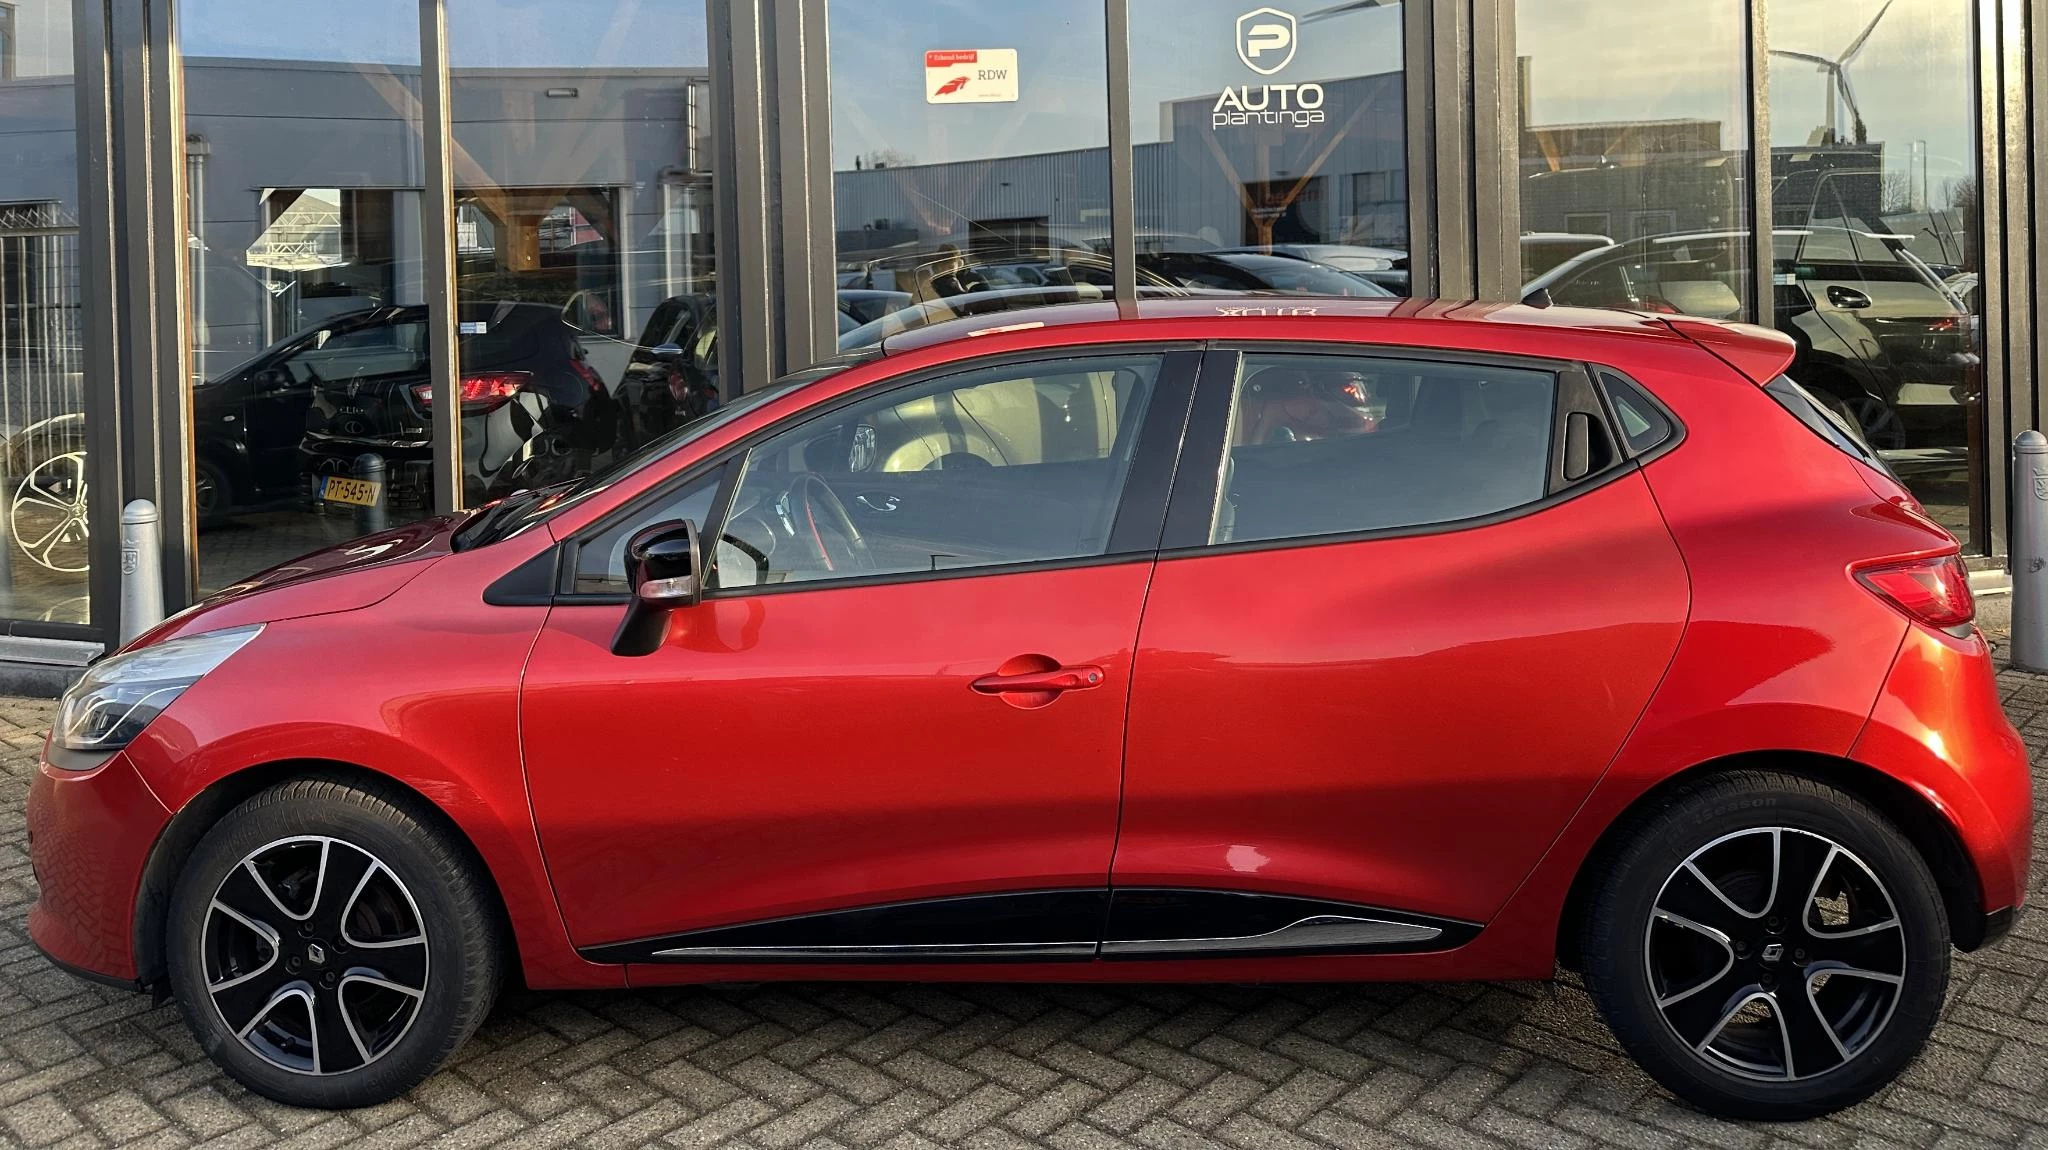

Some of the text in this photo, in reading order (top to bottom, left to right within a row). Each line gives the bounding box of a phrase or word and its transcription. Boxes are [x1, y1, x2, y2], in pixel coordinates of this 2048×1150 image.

[977, 69, 1008, 81] RDW
[1212, 83, 1324, 113] AUTO
[1212, 109, 1325, 131] plantinga
[327, 479, 377, 503] PT-545-N
